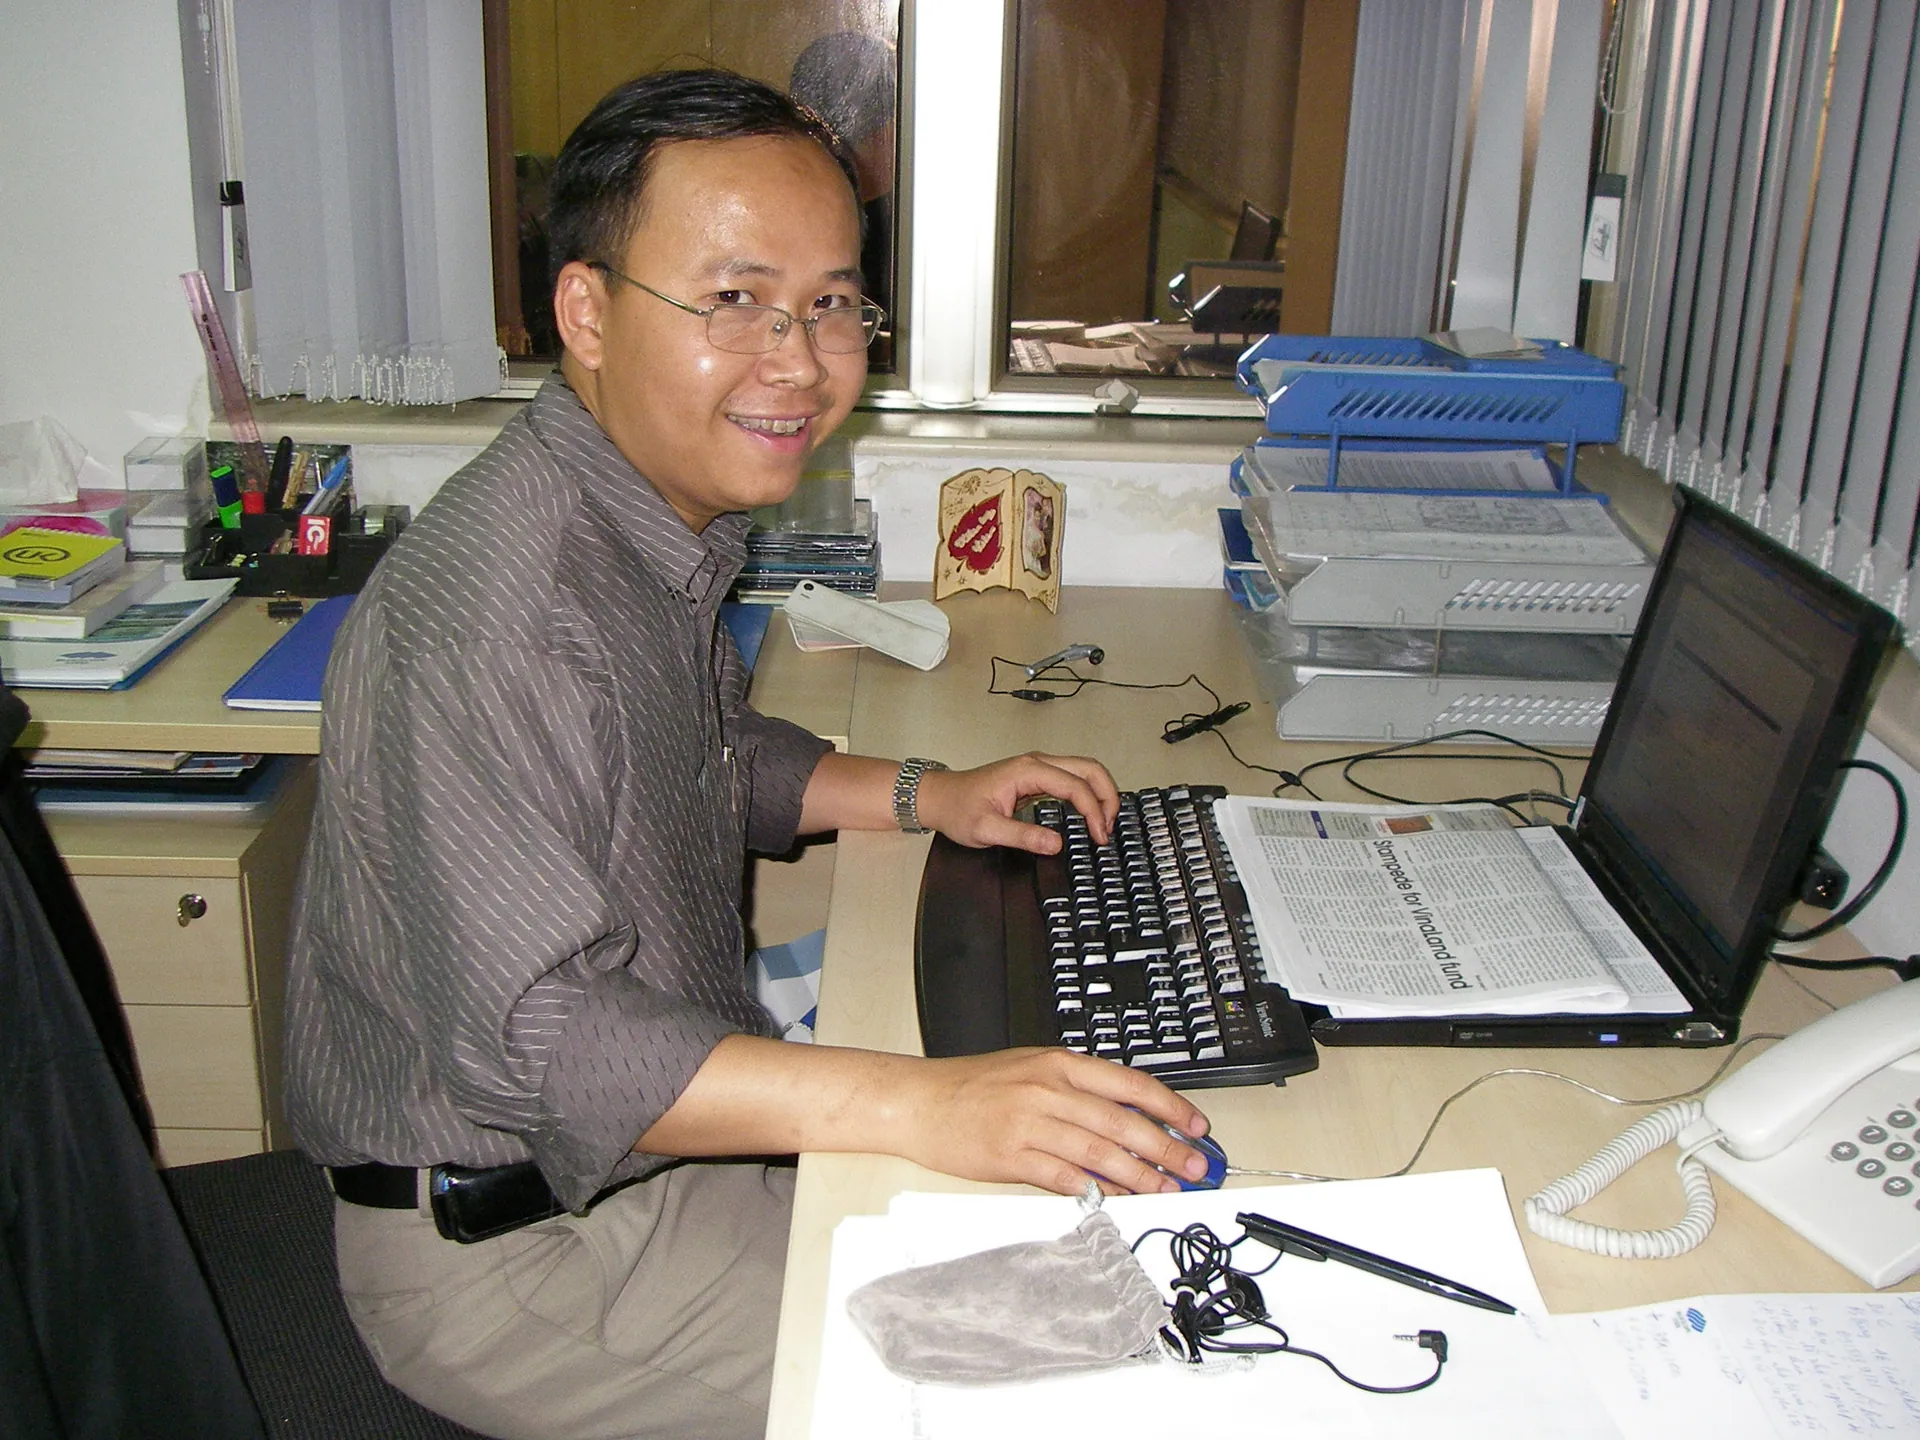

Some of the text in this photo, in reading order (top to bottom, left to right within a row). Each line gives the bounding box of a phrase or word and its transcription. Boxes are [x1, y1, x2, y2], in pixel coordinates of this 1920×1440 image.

[1373, 839, 1473, 990] Stampede for VinaLand fund
[1255, 1000, 1276, 1038] ViewSonic
